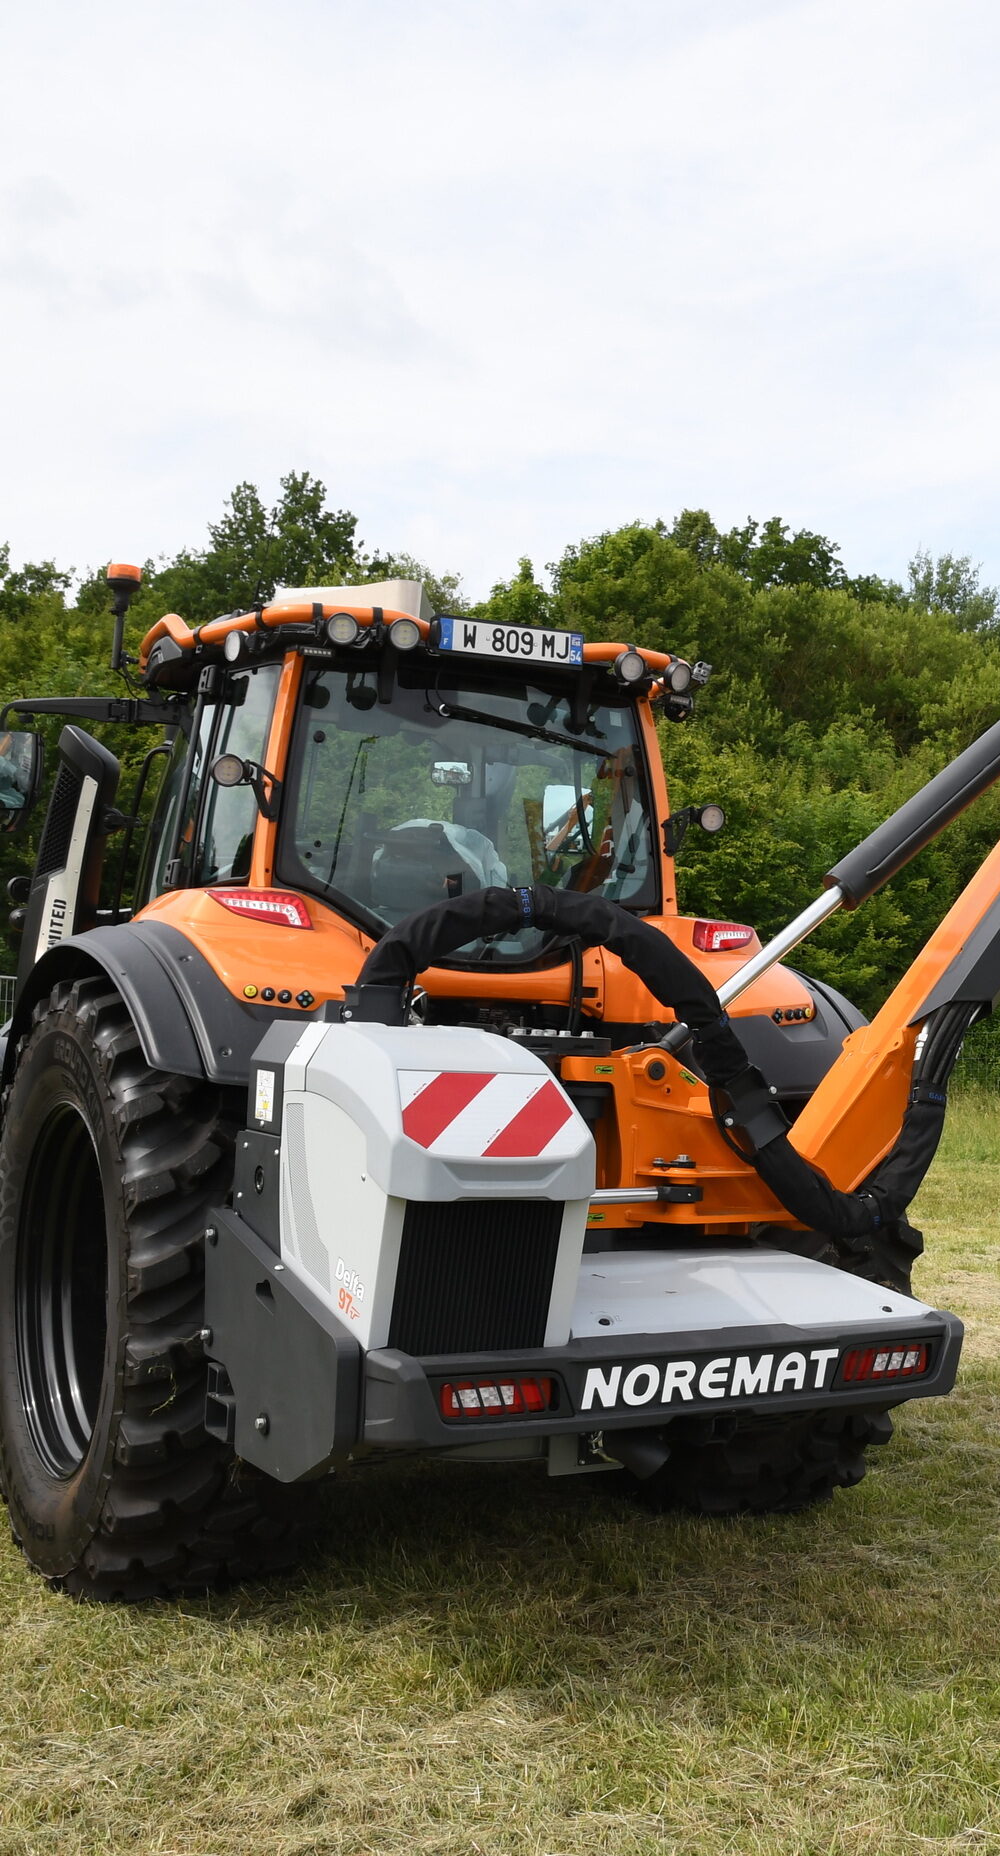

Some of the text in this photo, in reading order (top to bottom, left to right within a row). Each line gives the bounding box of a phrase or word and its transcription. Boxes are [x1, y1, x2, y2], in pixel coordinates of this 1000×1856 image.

[463, 624, 477, 649] W
[491, 628, 534, 656] 809
[541, 633, 570, 660] MJ
[570, 650, 581, 663] 54
[335, 1256, 365, 1302] Delta
[580, 1348, 840, 1411] NOREMAT
